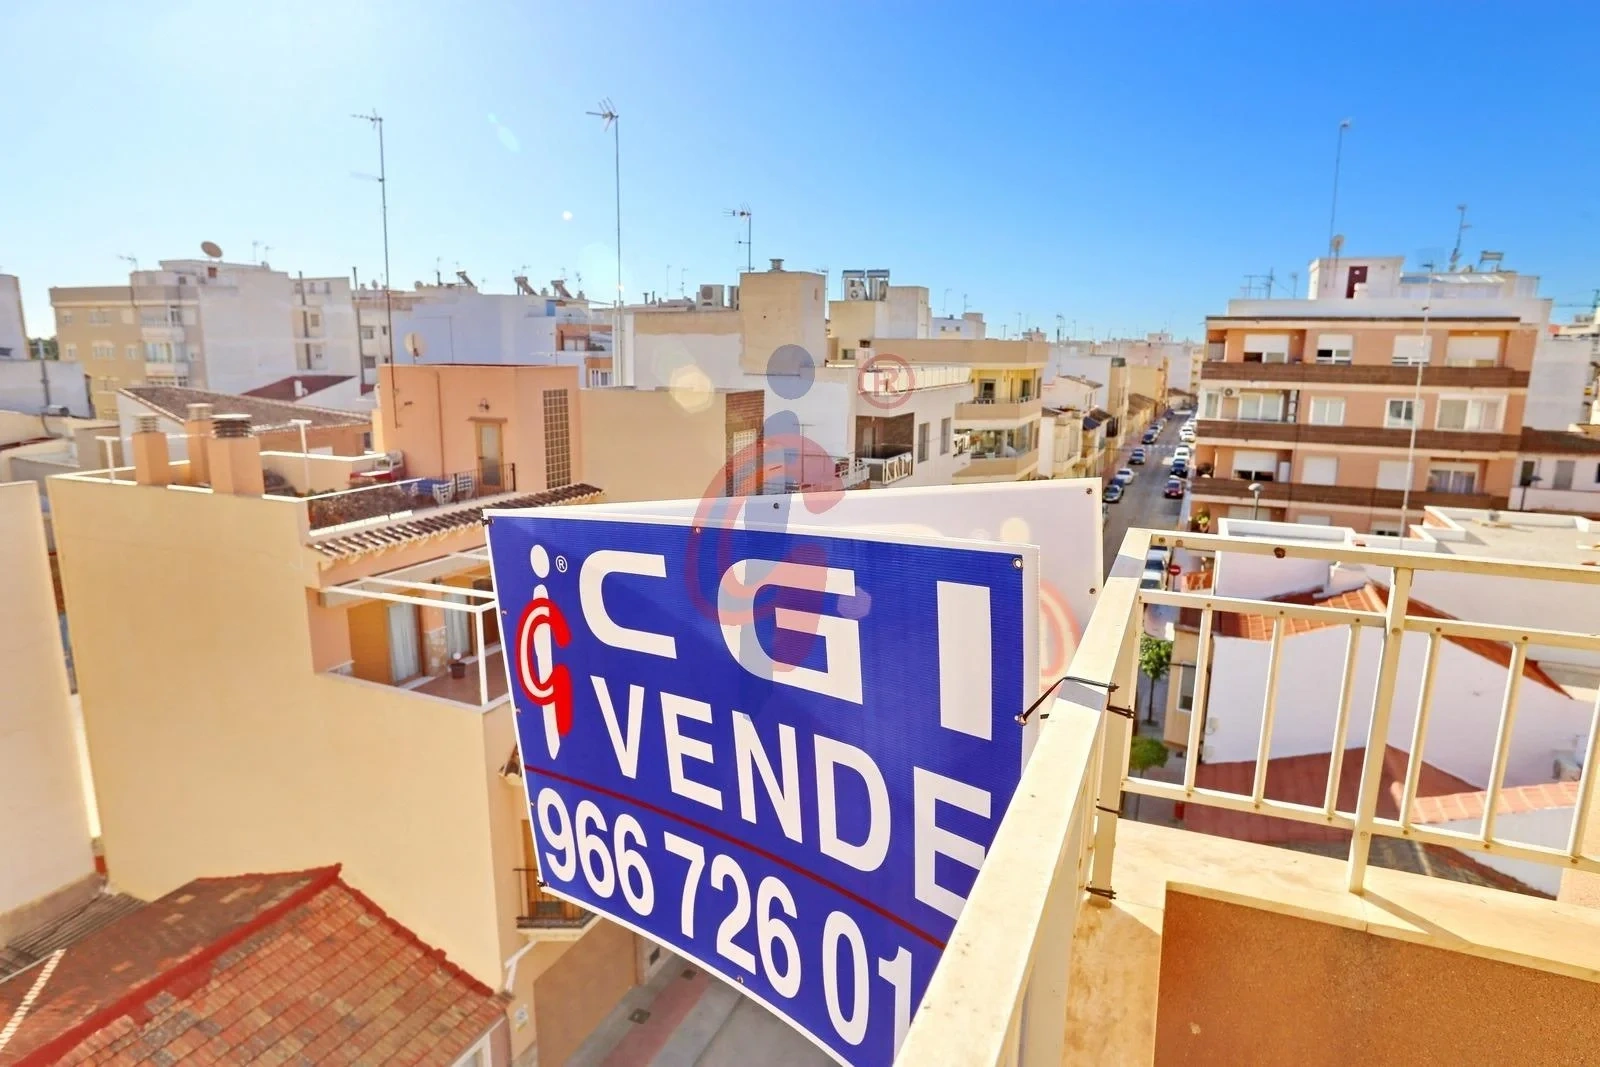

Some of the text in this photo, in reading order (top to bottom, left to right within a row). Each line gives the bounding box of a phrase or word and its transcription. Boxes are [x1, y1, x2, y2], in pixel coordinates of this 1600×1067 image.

[579, 549, 993, 741] CGI
[537, 787, 654, 917] 966
[664, 834, 800, 999] 726
[590, 675, 991, 921] VENDE
